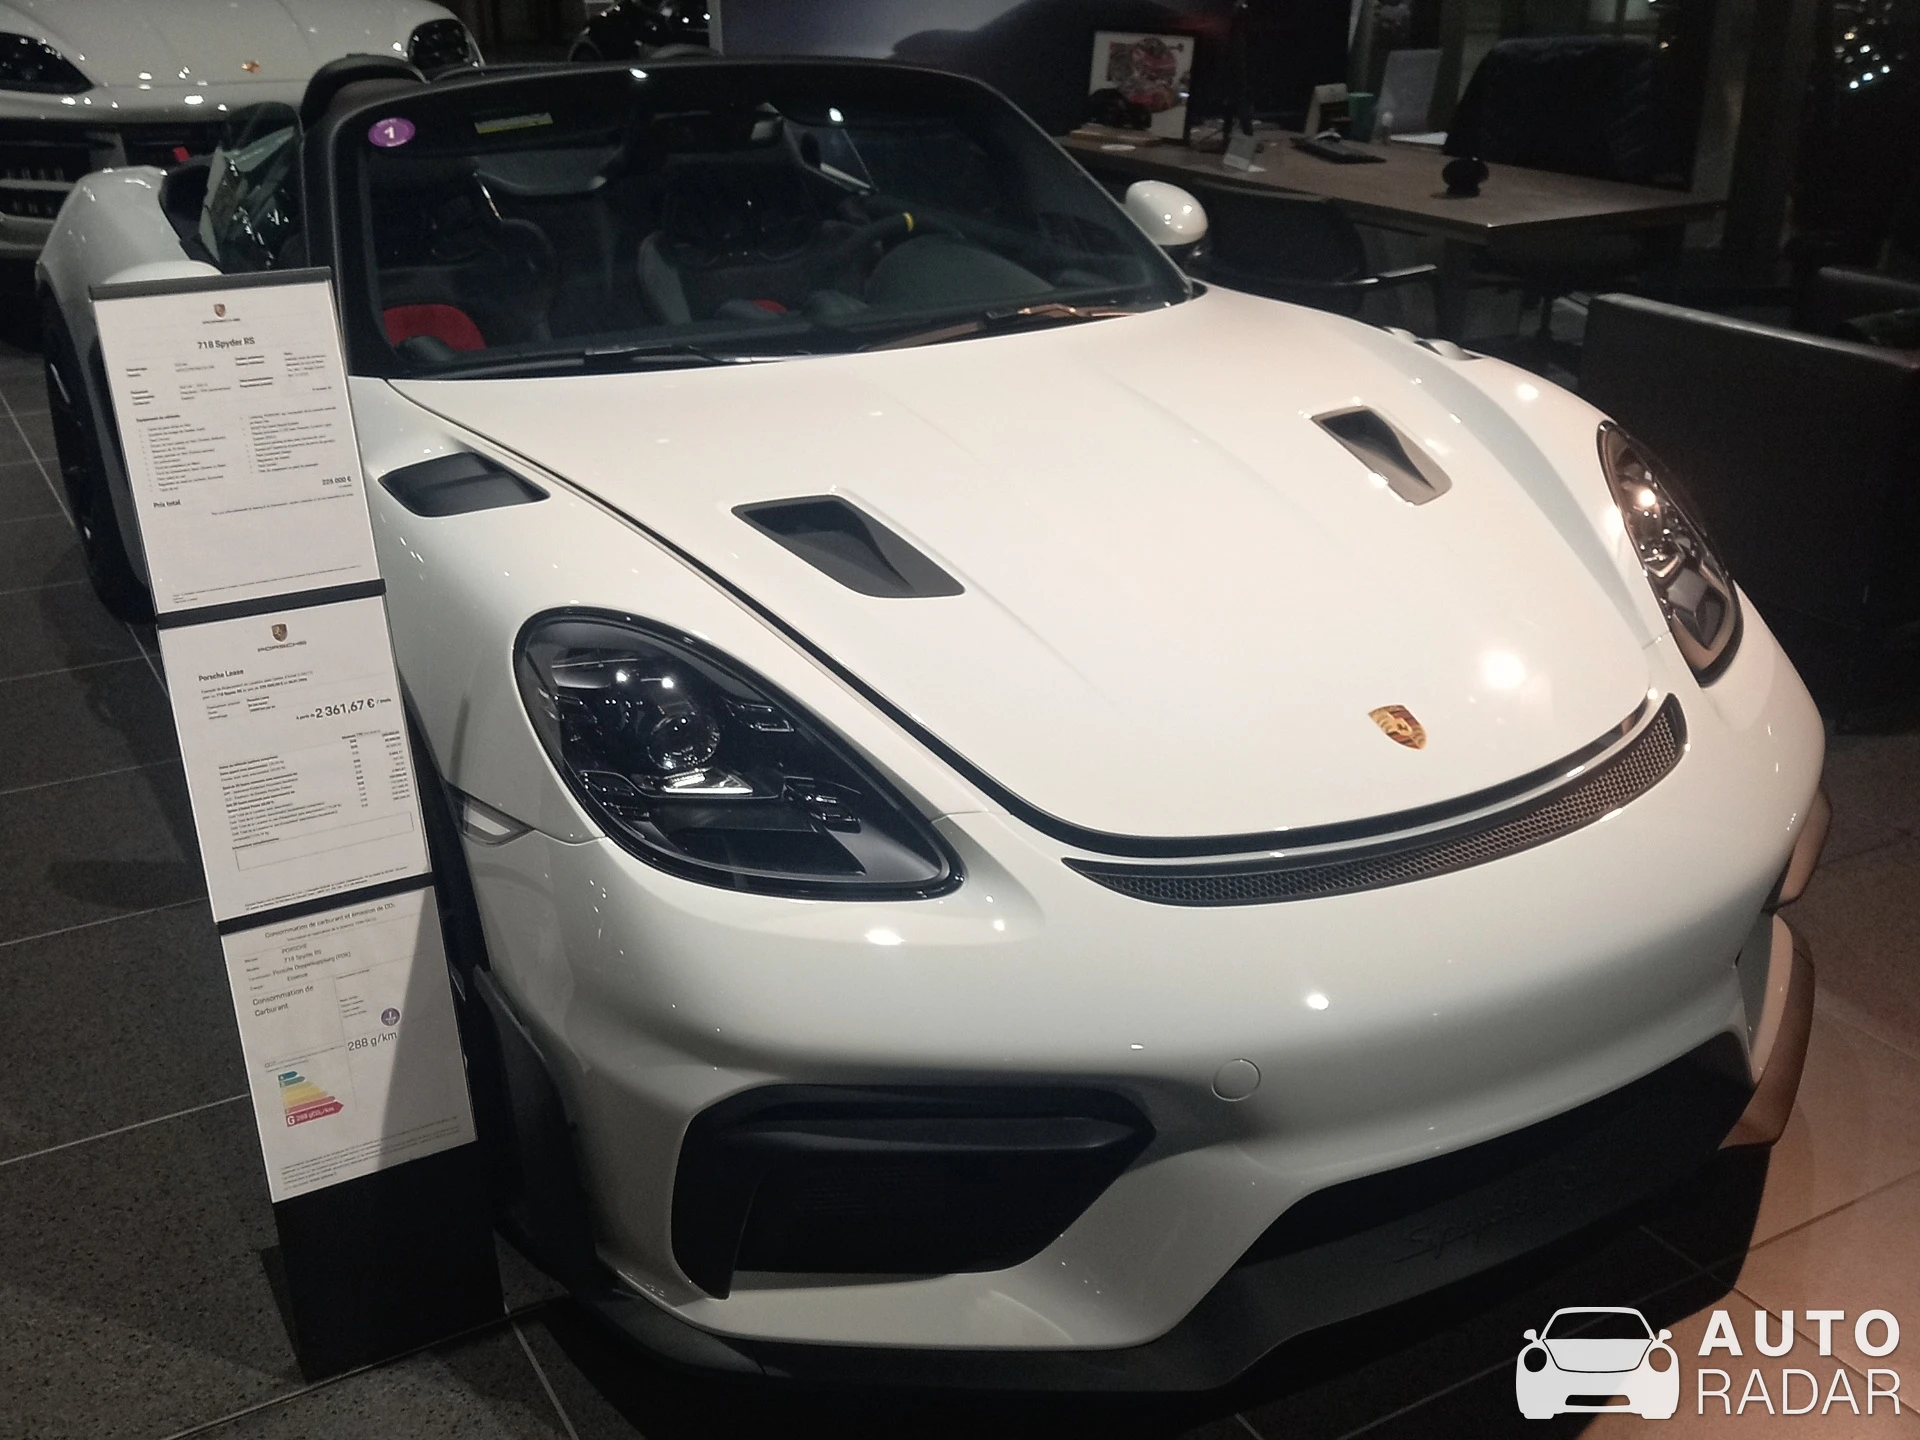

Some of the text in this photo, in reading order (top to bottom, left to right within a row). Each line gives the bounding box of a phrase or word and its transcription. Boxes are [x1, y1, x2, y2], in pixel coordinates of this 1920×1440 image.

[385, 126, 395, 139] 1
[197, 336, 255, 349] 718 Spyder RS
[258, 640, 306, 652] PORSCHE
[198, 669, 244, 682] Porsche Lease
[315, 708, 323, 718] 2
[325, 700, 364, 716] 361,67
[367, 698, 375, 708] €
[264, 922, 308, 938] Consommation
[317, 914, 344, 926] carburant
[253, 988, 304, 1006] Consommation
[254, 1003, 288, 1017] Carburant
[348, 1031, 398, 1051] 288 g/km
[288, 1116, 295, 1125] G
